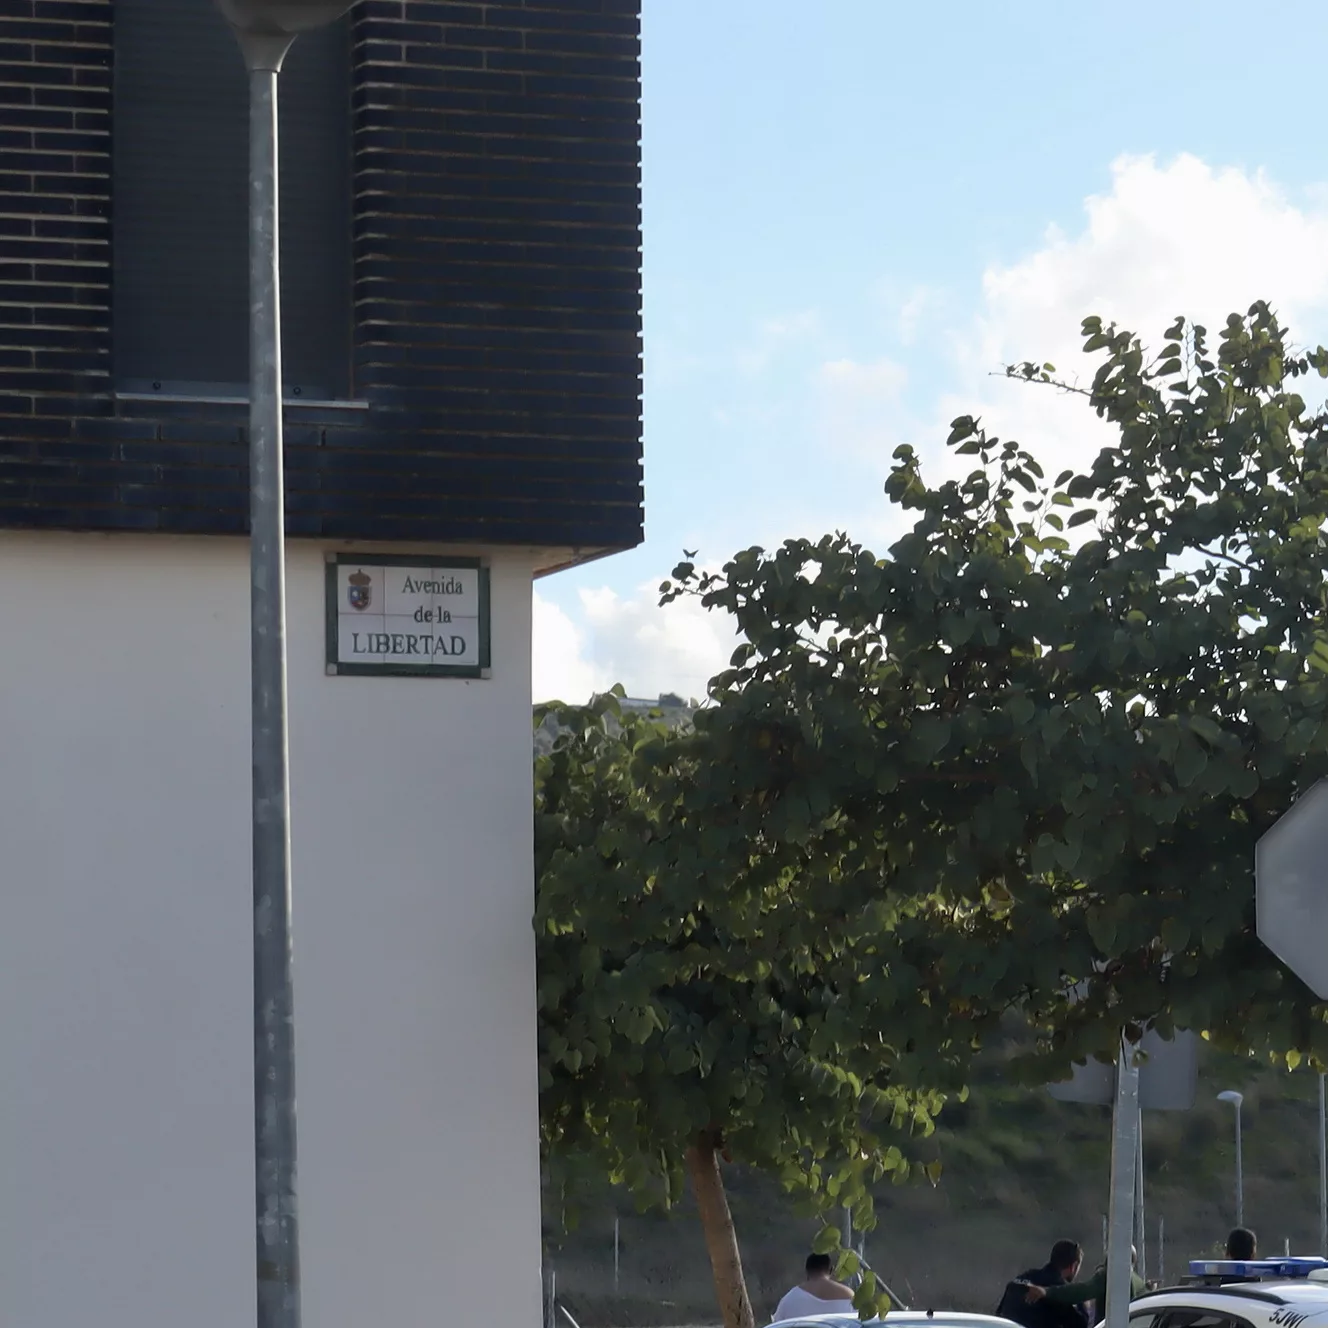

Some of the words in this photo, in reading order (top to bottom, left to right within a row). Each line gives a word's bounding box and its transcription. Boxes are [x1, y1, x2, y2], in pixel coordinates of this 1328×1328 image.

[402, 575, 463, 594] Avenida
[414, 606, 433, 622] de
[437, 606, 452, 623] la
[352, 633, 466, 656] LIBERTAD
